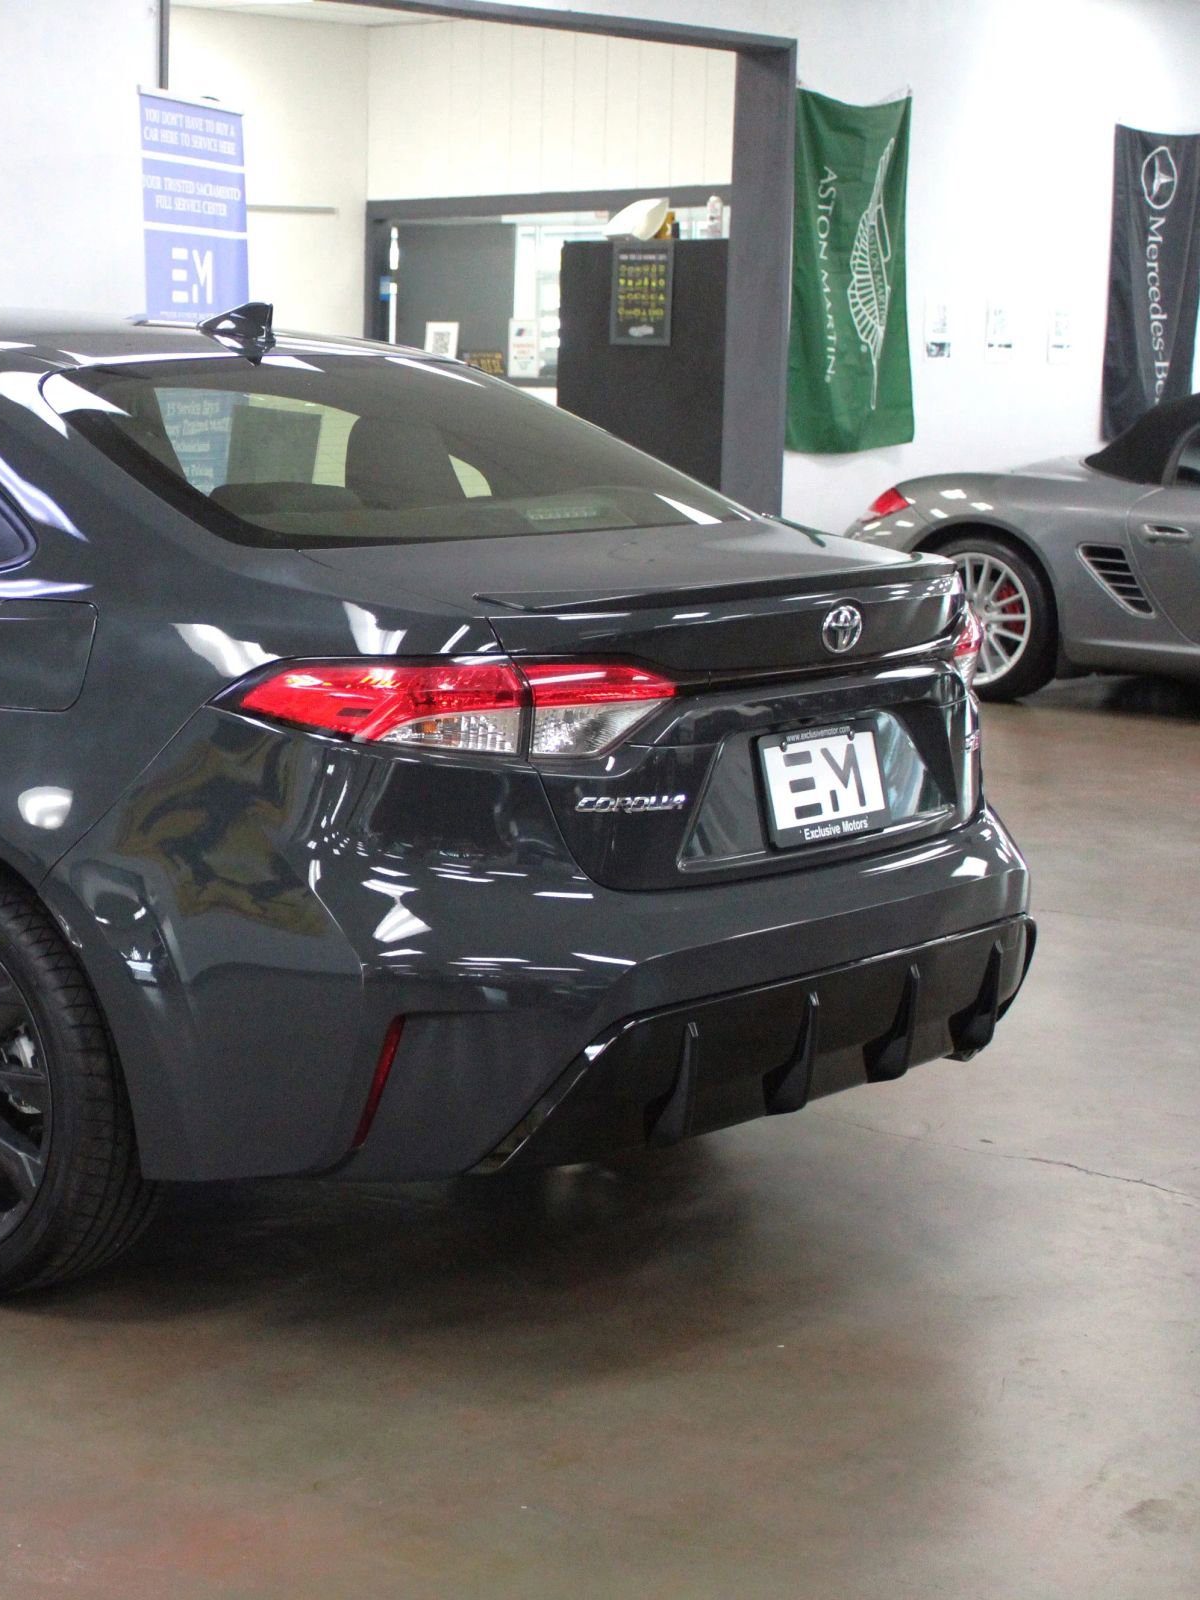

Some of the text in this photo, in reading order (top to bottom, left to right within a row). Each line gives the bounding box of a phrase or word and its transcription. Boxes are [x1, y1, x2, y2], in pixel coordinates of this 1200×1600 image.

[144, 108, 160, 125] YOU
[185, 115, 203, 131] HAVE
[205, 119, 214, 133] TO
[144, 126, 159, 142] CAR
[180, 132, 190, 148] TO
[191, 134, 218, 152] SERVICE
[163, 176, 194, 195] TRUSTED
[174, 196, 202, 214] SERVICE
[203, 200, 227, 216] CENTER
[172, 248, 213, 304] EM
[817, 166, 838, 375] ASTON MARTIN
[1146, 216, 1170, 405] Mercedes-Be
[783, 743, 866, 820] EM
[575, 794, 686, 814] COROLLA
[804, 817, 869, 840] Exclusive Motors
